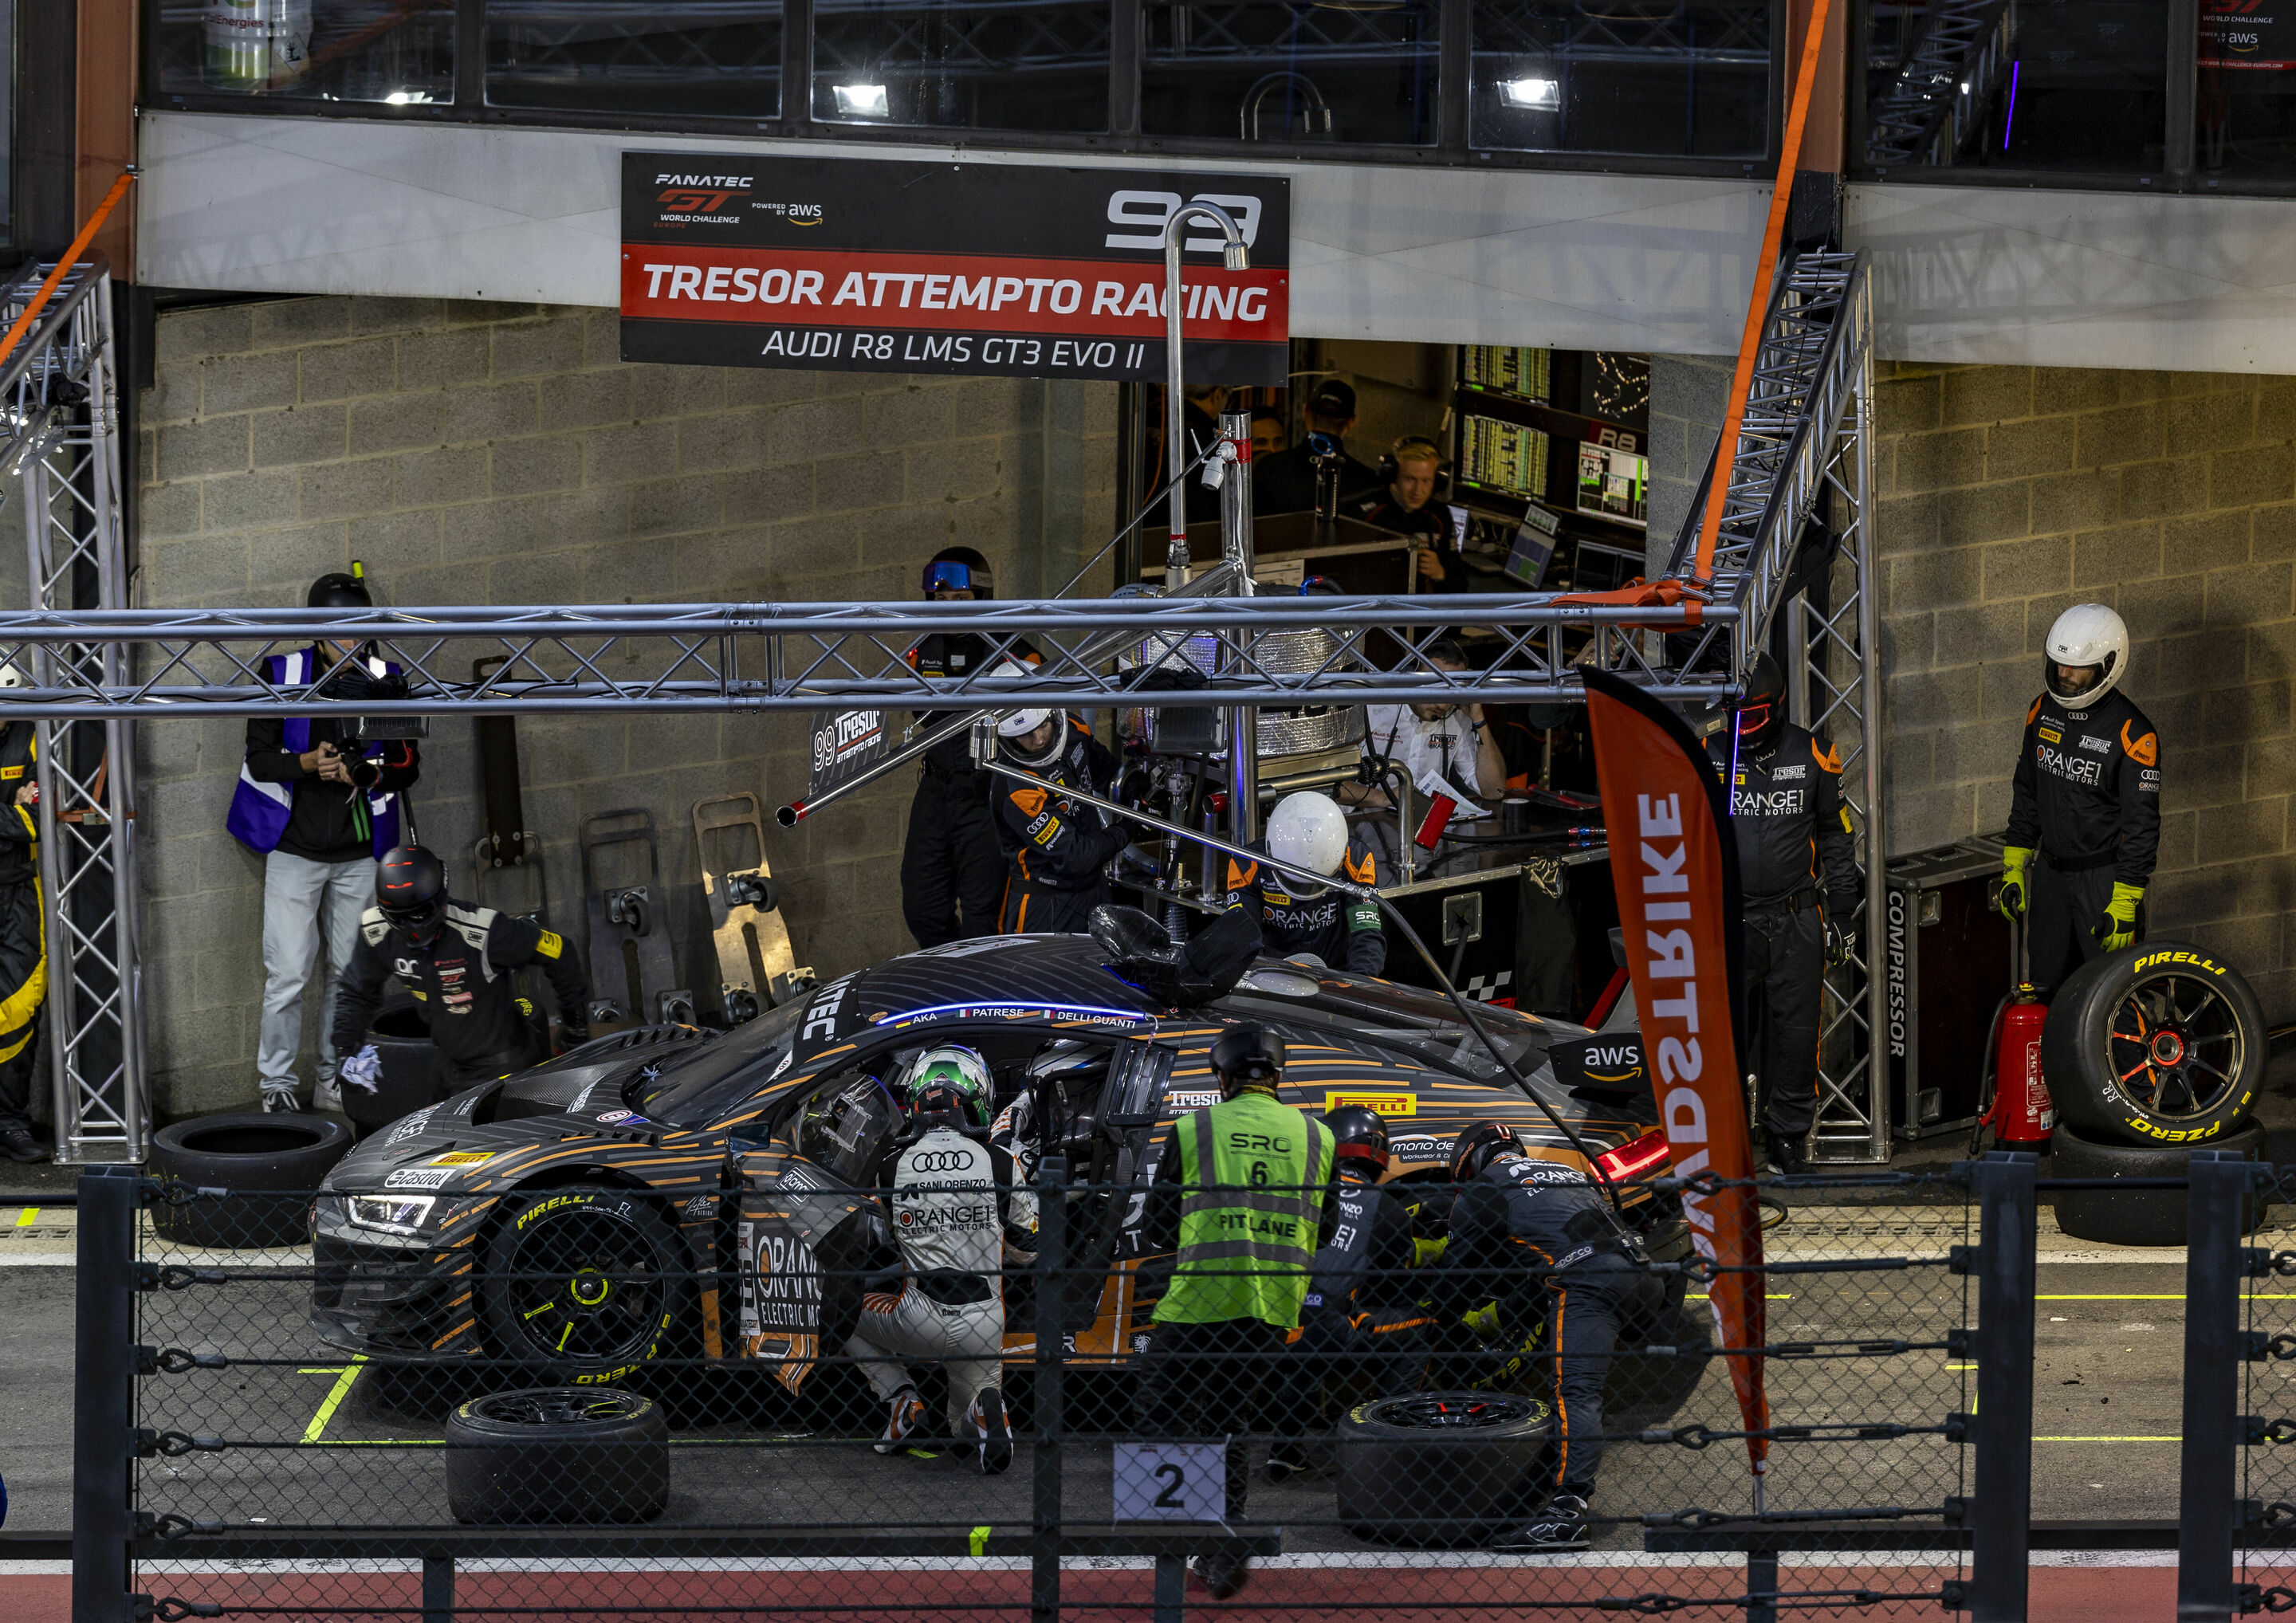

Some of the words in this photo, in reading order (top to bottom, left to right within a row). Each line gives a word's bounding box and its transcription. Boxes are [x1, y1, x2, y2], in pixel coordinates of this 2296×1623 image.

[2229, 33, 2258, 44] aws
[655, 174, 753, 188] FANATEC
[660, 214, 691, 222] WORLD
[692, 215, 740, 224] CHALLENGE
[789, 203, 822, 217] aws
[1105, 190, 1261, 253] 99
[643, 264, 824, 305] TRESOR
[832, 271, 1083, 315] ATTEMPTO
[762, 331, 842, 358] AUDI
[851, 333, 894, 360] R8
[904, 336, 973, 363] LMS
[982, 339, 1040, 365] GT3
[1051, 341, 1116, 367] EVO
[1125, 344, 1145, 369] II
[1597, 427, 1637, 453] R8
[815, 725, 835, 772] 99
[835, 710, 880, 747] Tresor
[2041, 729, 2058, 741] PIRELLI
[2081, 735, 2112, 749] Tresor
[1773, 765, 1807, 776] Tresor
[2036, 745, 2102, 780] ORANGE1
[2066, 772, 2099, 786] MOTORS
[1733, 789, 1804, 809] RANGE1
[1765, 806, 1803, 816] MOTORS
[1263, 894, 1287, 903] PIRELLI
[2134, 951, 2227, 975] PIRELLI
[1889, 890, 1905, 1058] COMPRESSOR
[913, 1012, 938, 1024] AKA
[973, 1008, 1024, 1017] PATRESE
[1057, 1011, 1089, 1022] DELLI
[1091, 1015, 1136, 1029] GUANTI
[1585, 1046, 1639, 1066] aws
[1169, 1091, 1223, 1107] Treso
[1392, 1141, 1433, 1152] mario
[438, 1154, 487, 1164] PIRELLI
[400, 1170, 446, 1187] Castrol
[919, 1178, 987, 1189] SANLORENZO
[1252, 1161, 1268, 1186] 6
[900, 1205, 990, 1228] ORANGE1
[1219, 1214, 1247, 1229] PIT
[1249, 1215, 1297, 1238] LANE
[902, 1225, 945, 1235] ELECTRIC
[952, 1223, 991, 1232] MOTORS
[1555, 1245, 1593, 1270] sparco
[757, 1235, 824, 1301] ORAN
[761, 1302, 804, 1327] ELECTRIC
[1154, 1463, 1185, 1508] 2
